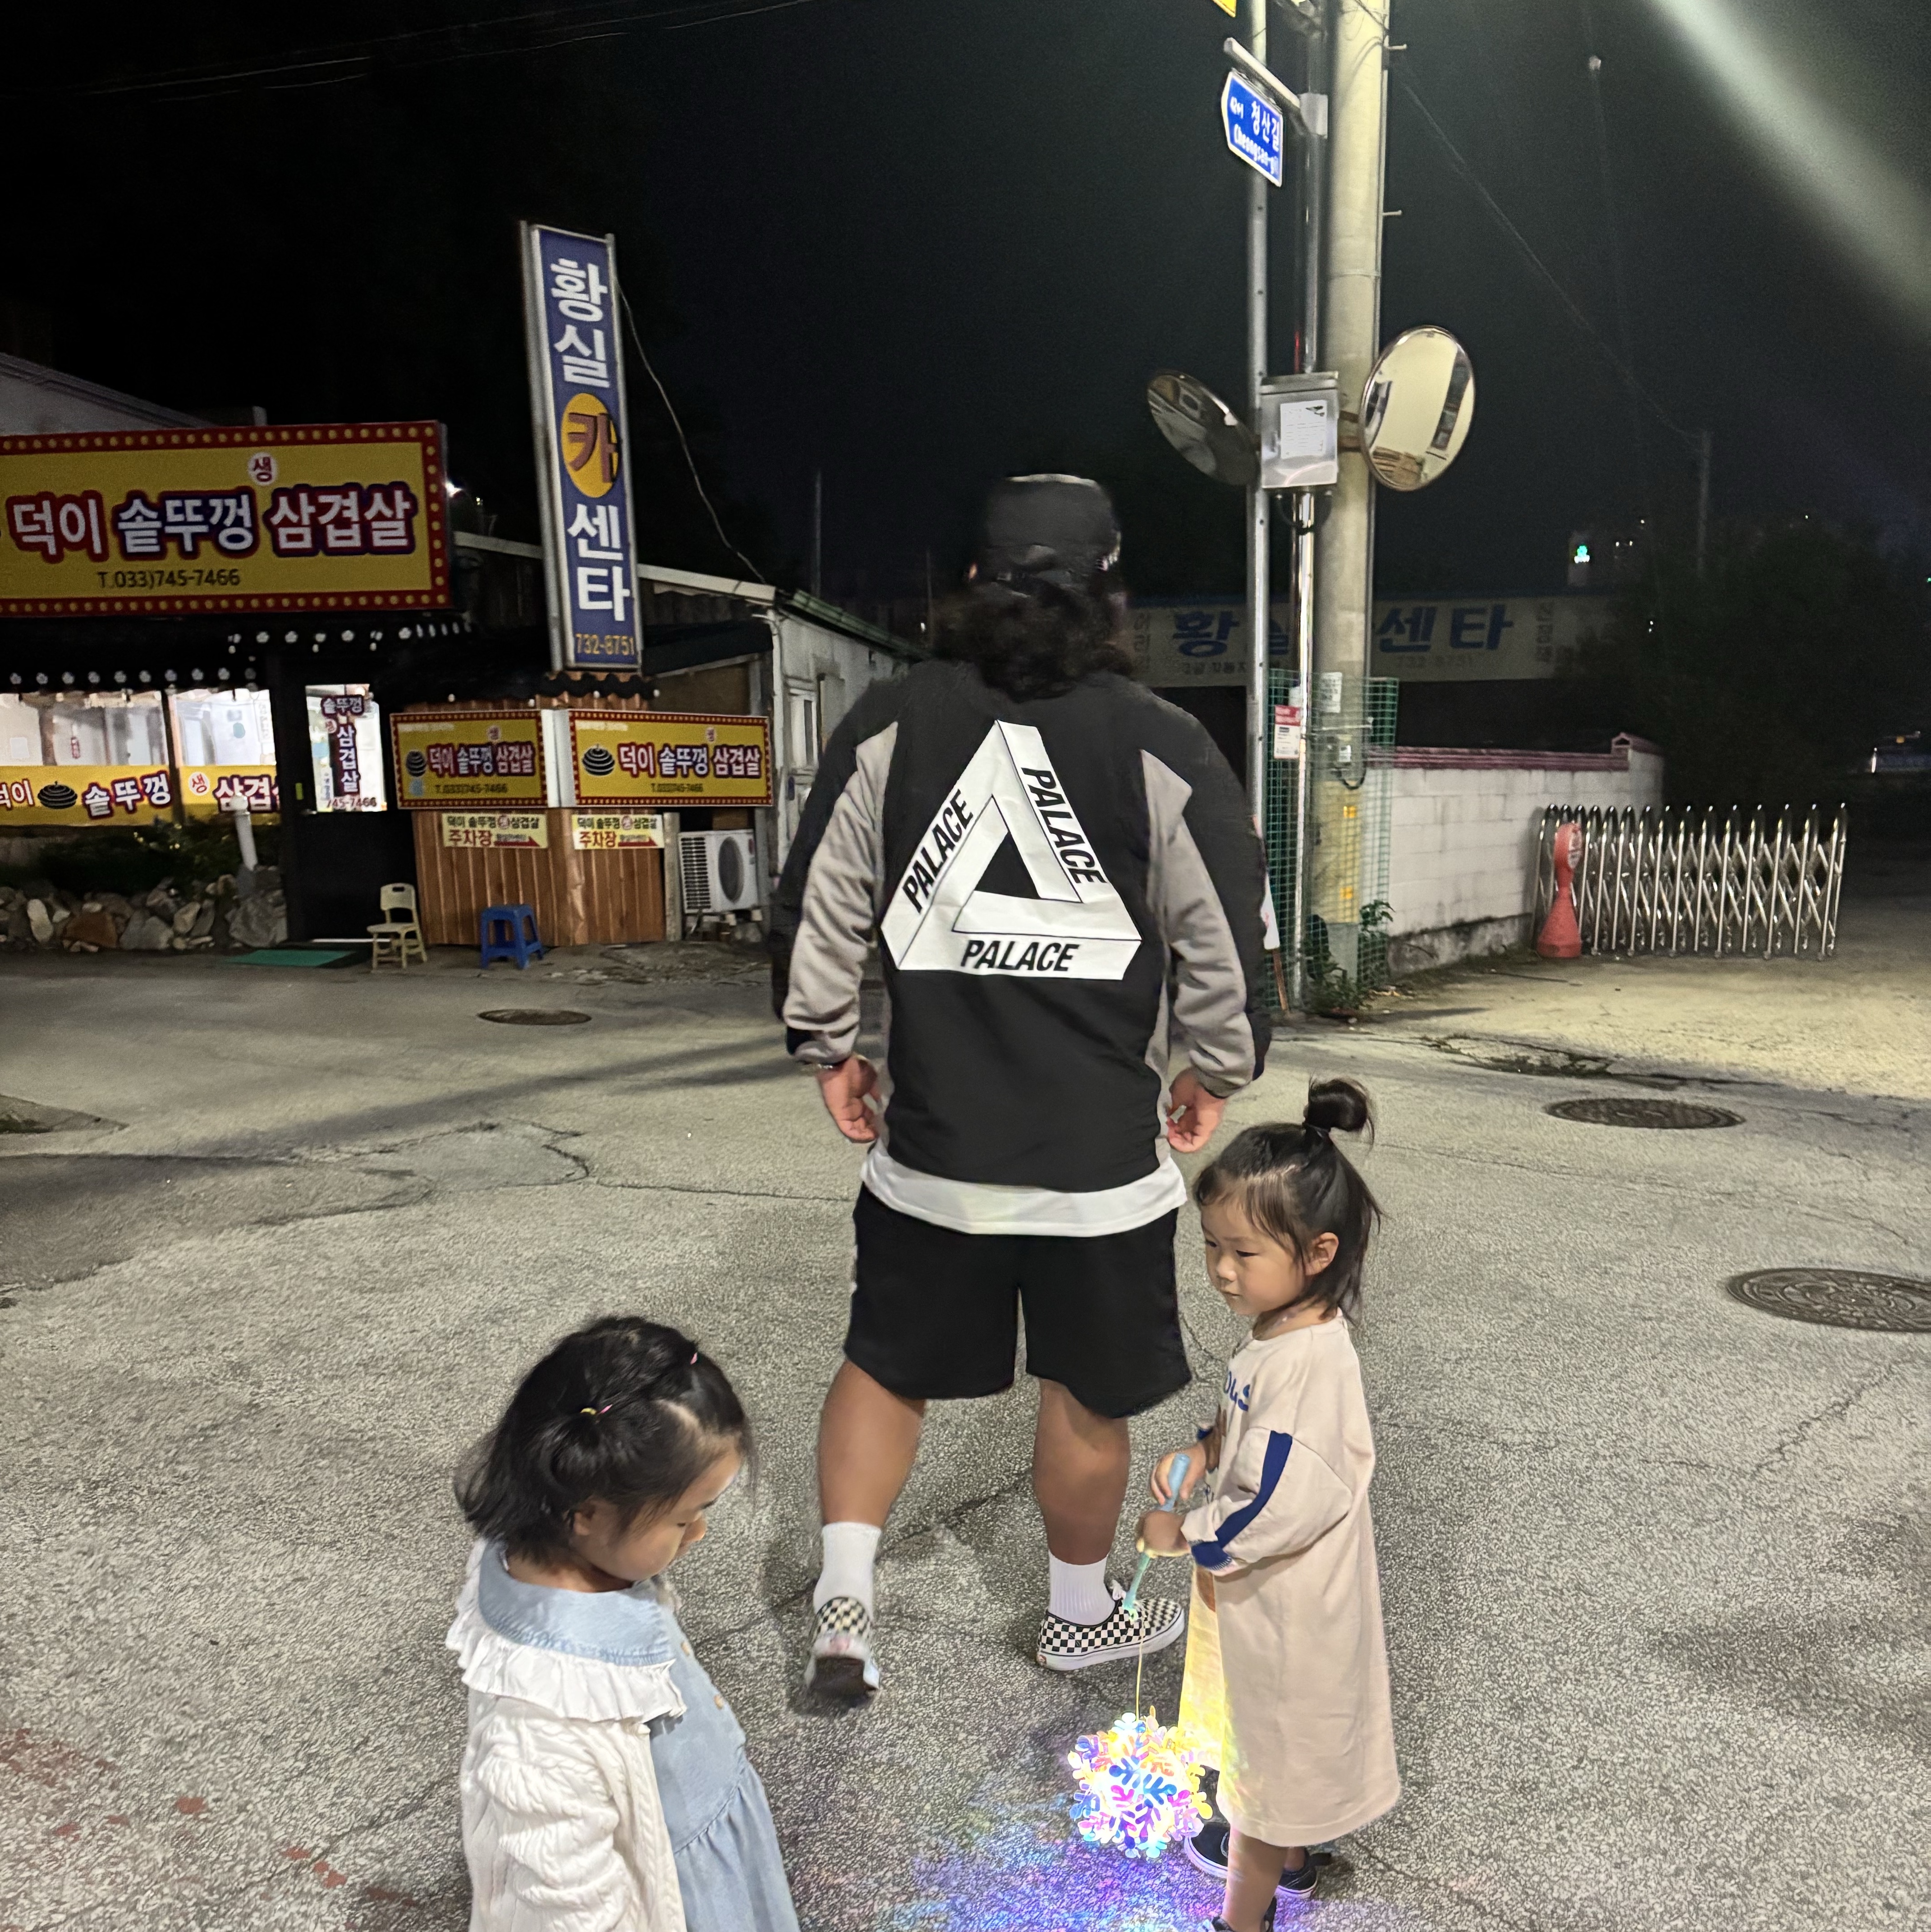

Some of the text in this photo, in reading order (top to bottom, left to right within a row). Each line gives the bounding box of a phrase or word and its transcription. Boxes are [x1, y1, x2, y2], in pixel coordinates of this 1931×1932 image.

[1251, 101, 1280, 152] 청산길
[252, 454, 274, 484] 생
[13, 490, 412, 556] 덕이 솥뚜껑 삼겹살
[576, 633, 635, 656] 732-8751
[337, 726, 359, 793] 삼겹살
[429, 744, 533, 775] 덕이 솥뚜껑 삼겹살
[619, 746, 761, 776] 덕이 솥뚜껑 삼겹살
[85, 773, 171, 815] 솥뚜껑
[190, 775, 280, 811] 생 삼겹
[449, 829, 492, 847] 주차장
[579, 831, 617, 848] 주차장
[1020, 767, 1108, 885] PALACE
[902, 789, 974, 914] PALACE
[960, 940, 1082, 972] PALACE
